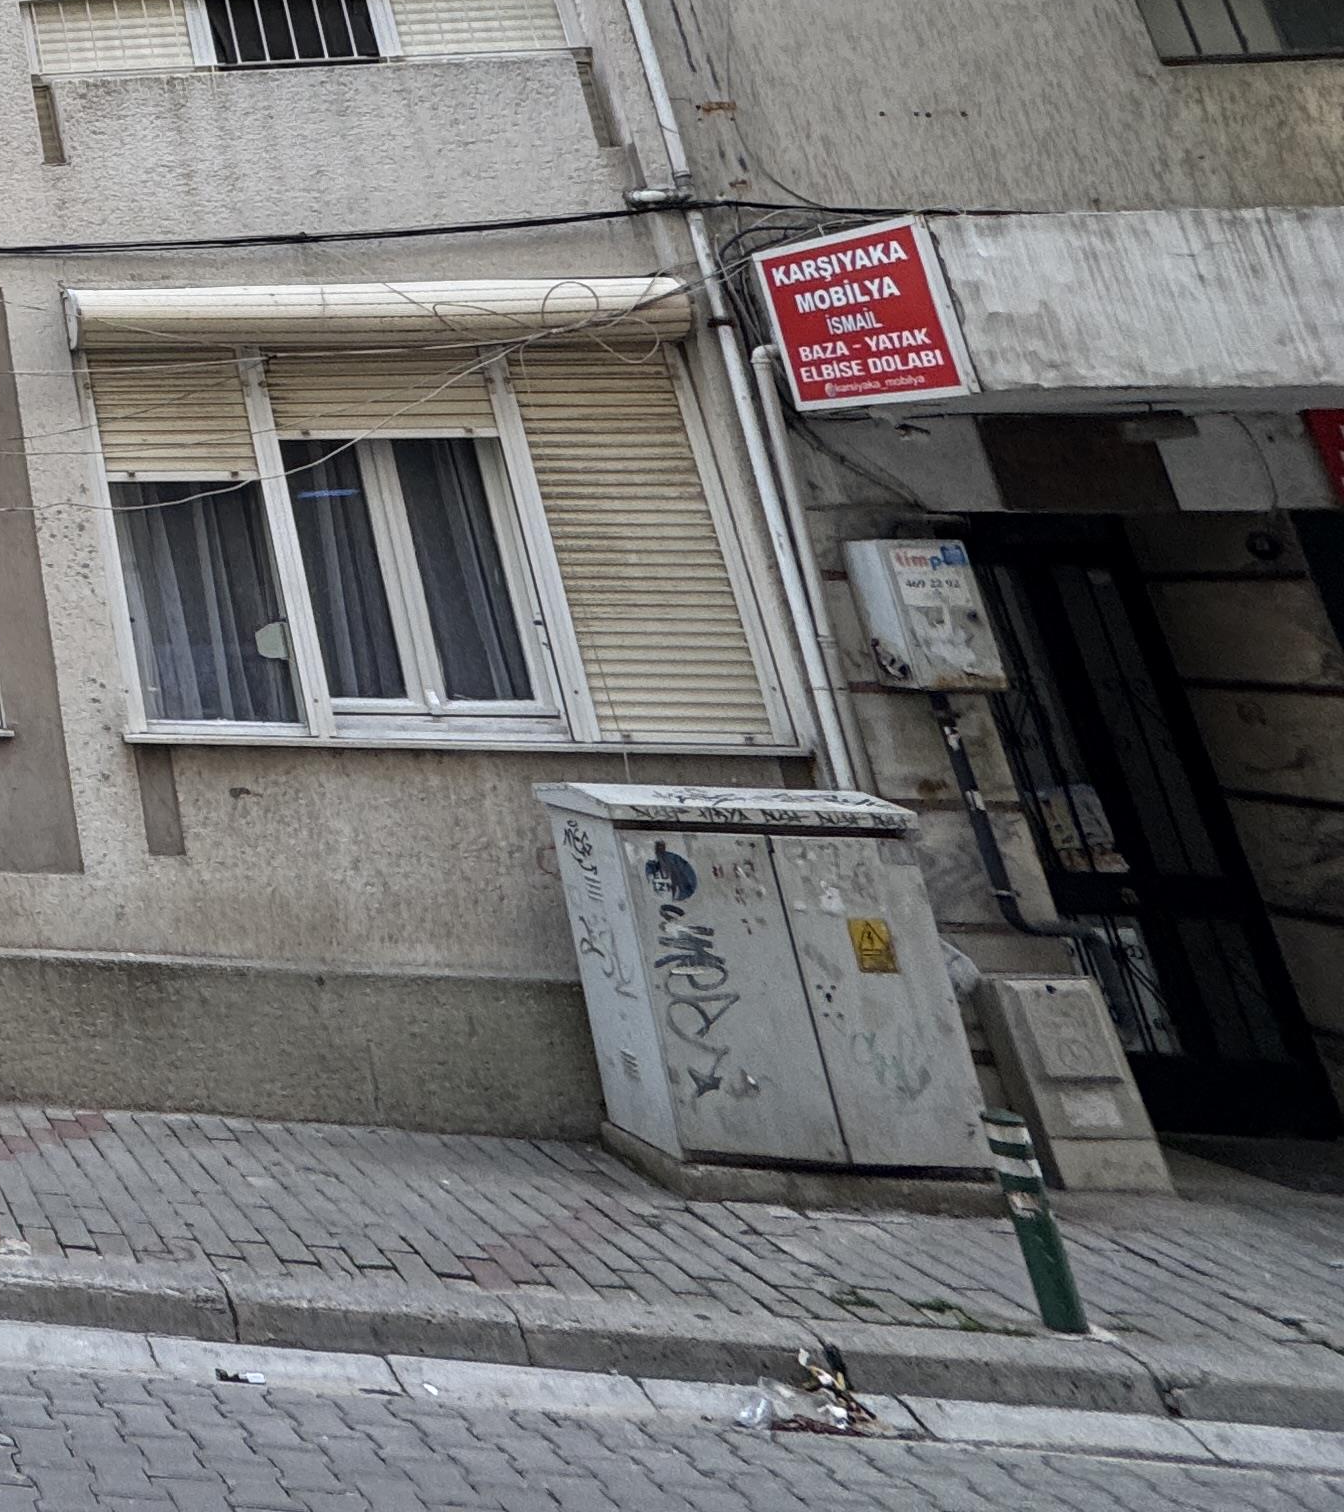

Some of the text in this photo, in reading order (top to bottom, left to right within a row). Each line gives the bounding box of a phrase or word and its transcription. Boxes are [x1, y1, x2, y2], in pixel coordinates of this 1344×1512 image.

[771, 240, 909, 286] KARŞIYAKA
[794, 276, 901, 313] MOBİLYA
[825, 307, 883, 335] İSMAİL
[799, 341, 850, 362] BAZA
[865, 328, 932, 352] YATAK
[799, 349, 945, 383] ELBİSE DOLABI
